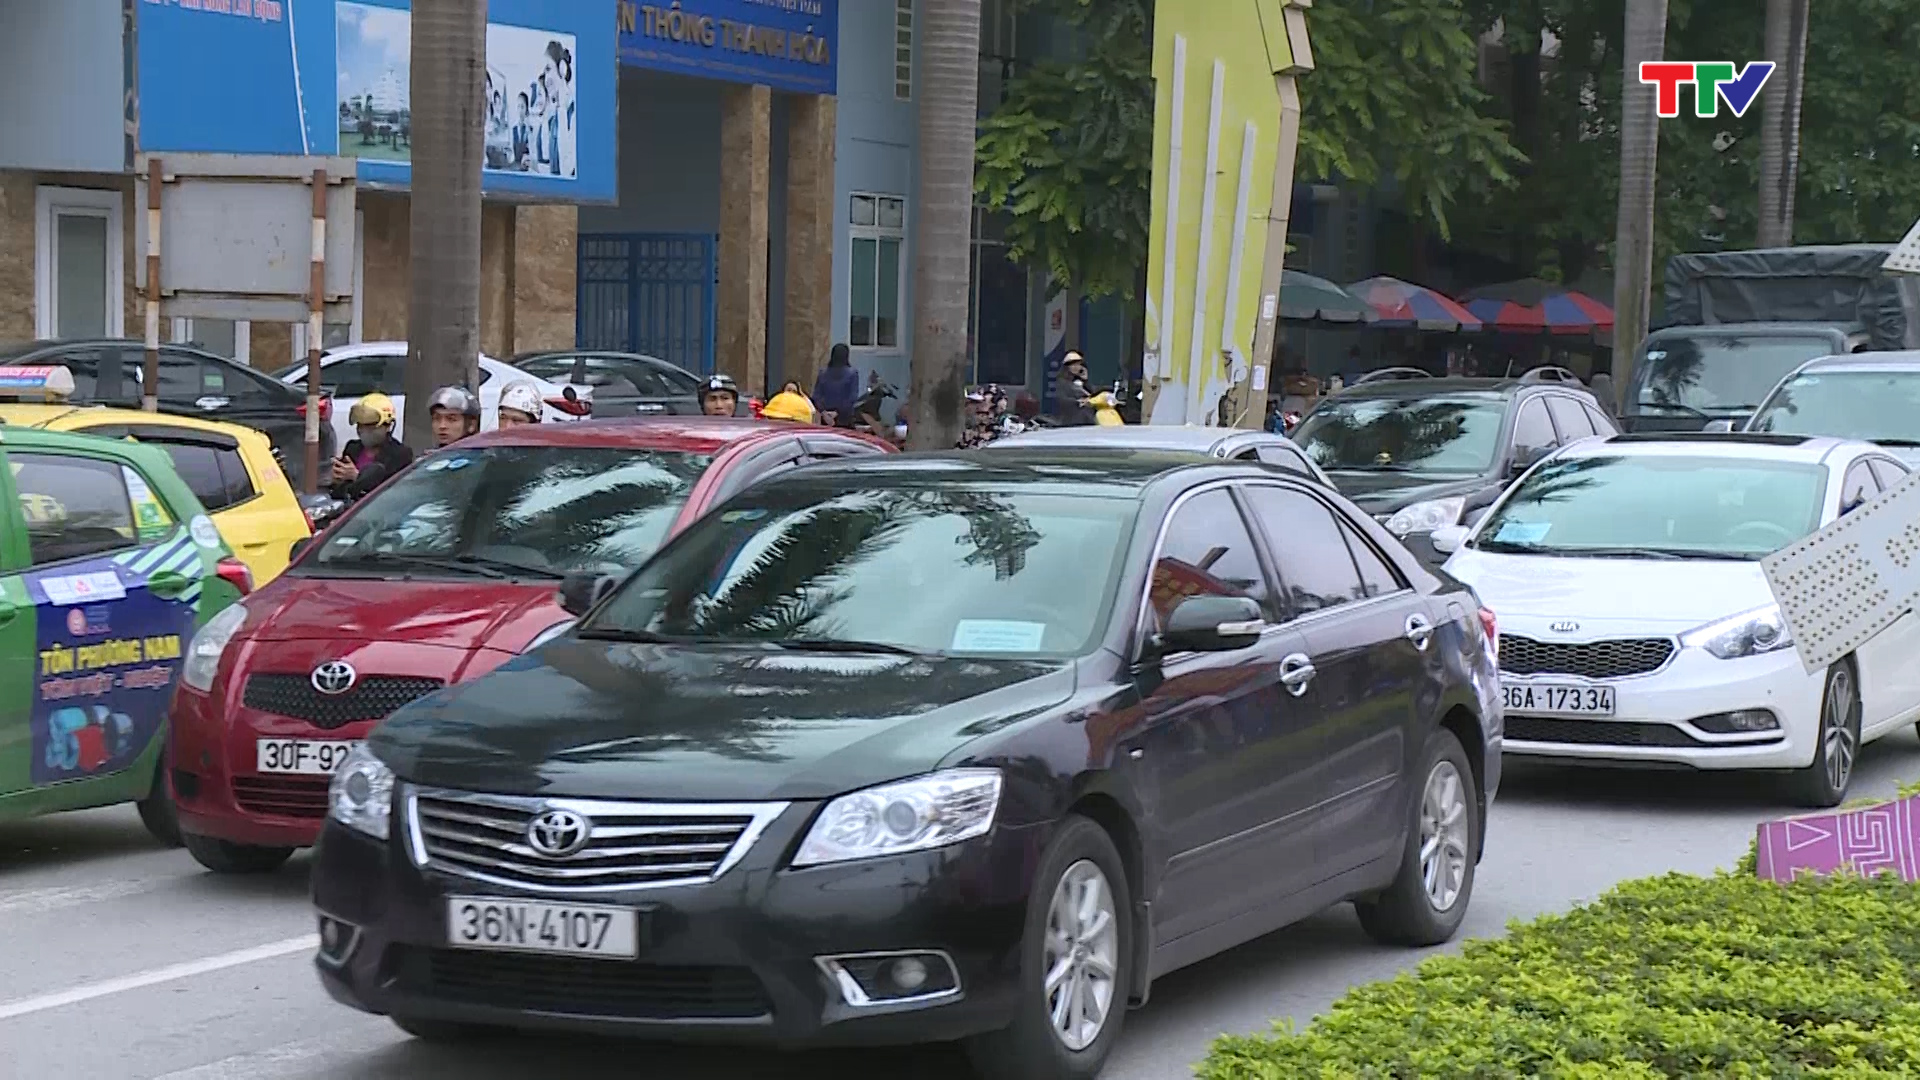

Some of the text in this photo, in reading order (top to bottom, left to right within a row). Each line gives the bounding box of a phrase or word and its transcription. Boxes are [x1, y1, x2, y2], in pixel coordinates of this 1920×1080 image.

[641, 1, 714, 47] THÔNG
[718, 18, 787, 58] THANH
[789, 23, 831, 64] HÓA
[1553, 621, 1578, 631] KIA
[1501, 686, 1611, 711] 36A-173.34
[266, 741, 357, 771] 30F-92
[461, 904, 613, 950] 36N-4107
